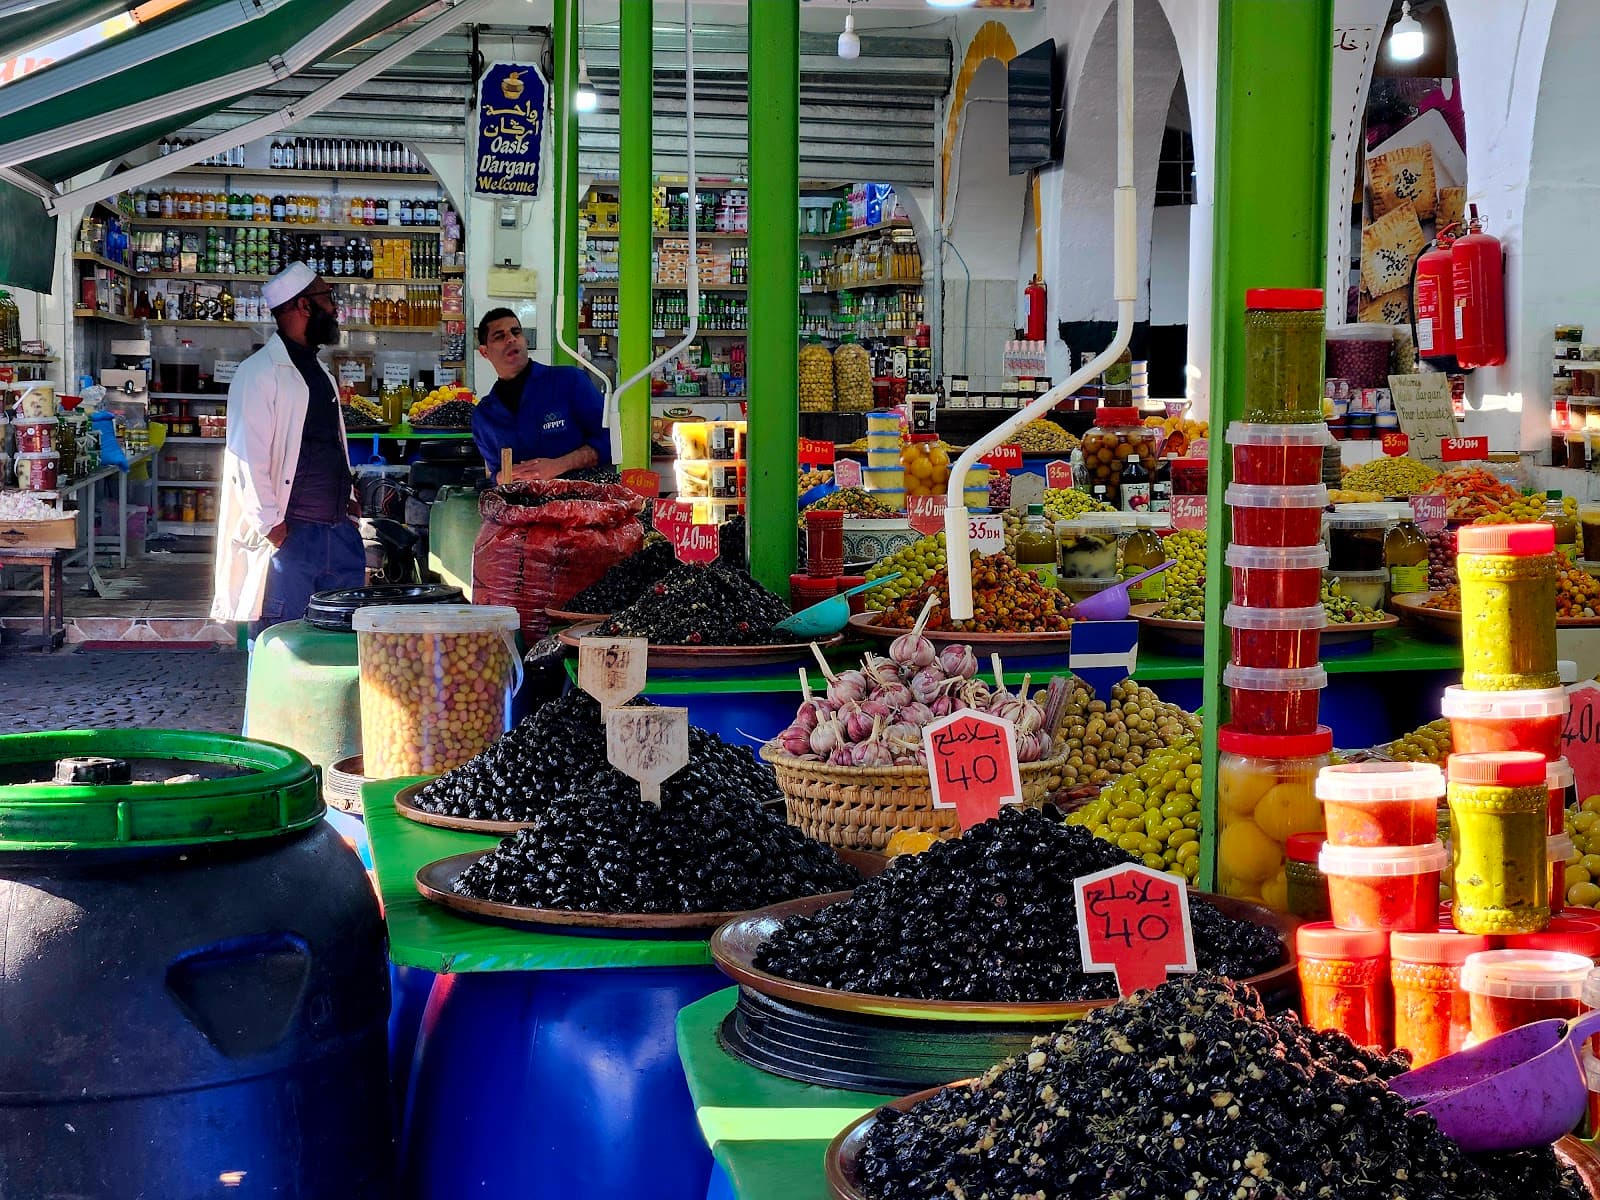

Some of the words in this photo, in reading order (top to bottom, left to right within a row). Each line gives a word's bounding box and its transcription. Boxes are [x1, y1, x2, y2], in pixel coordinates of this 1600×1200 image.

[490, 136, 529, 154] Oasis
[480, 155, 536, 179] D'argan
[478, 176, 535, 193] Welcome
[543, 419, 565, 430] OFPPT
[1383, 435, 1407, 448] 35DH
[1447, 438, 1479, 450] 30DH
[1049, 466, 1069, 479] 35DH
[914, 497, 945, 518] 40DH
[1176, 498, 1204, 518] 35DH
[1415, 498, 1442, 518] 35DH
[680, 526, 713, 551] 40DH
[969, 521, 1001, 540] 35DH
[945, 755, 998, 790] 40
[1104, 914, 1169, 948] 40
